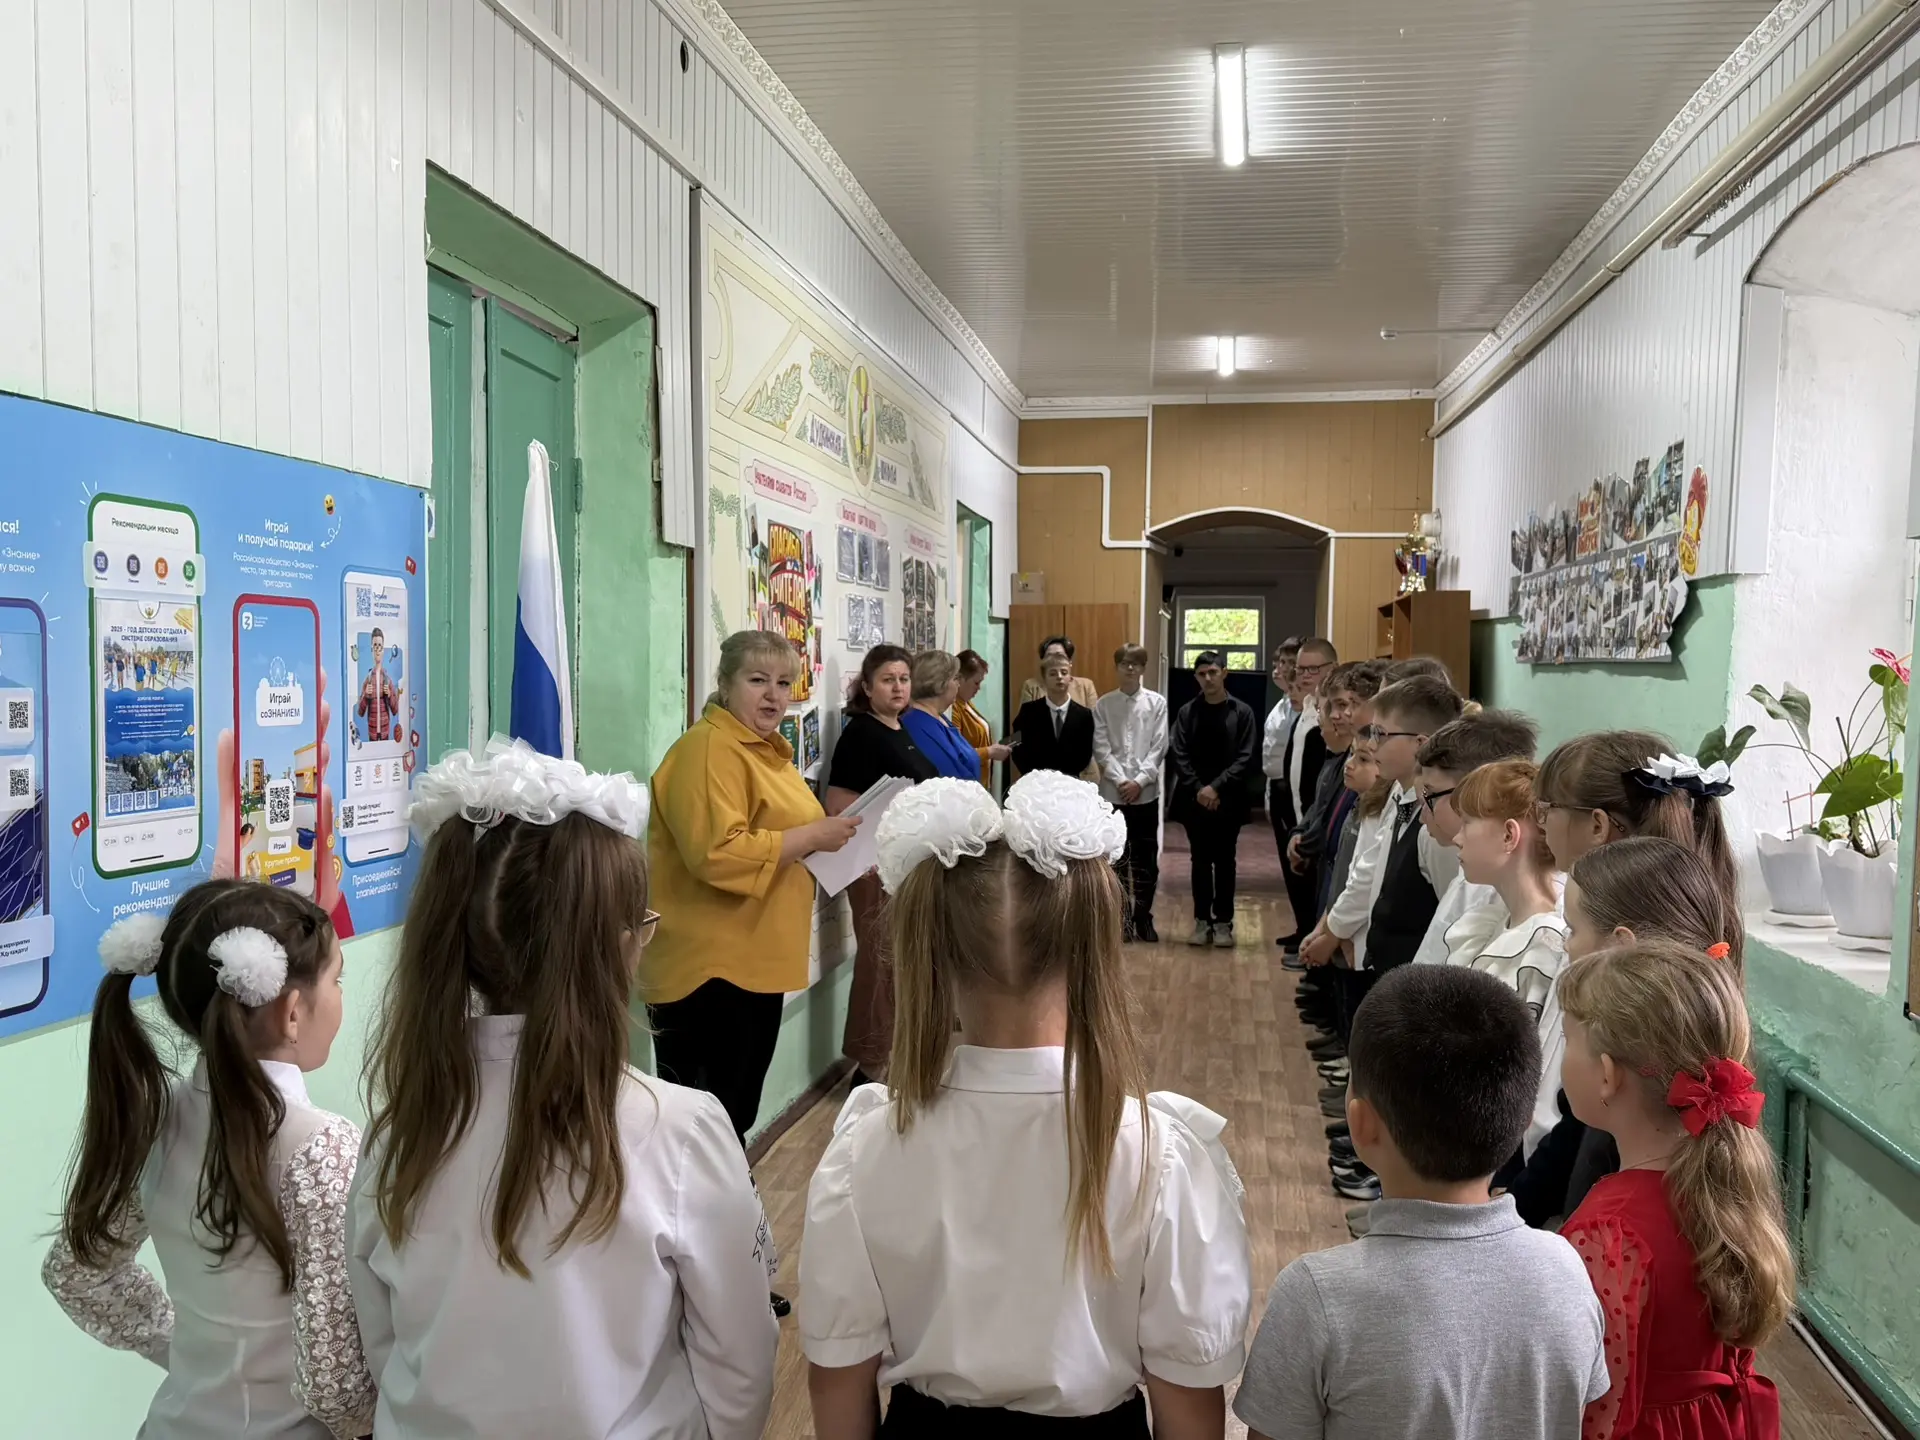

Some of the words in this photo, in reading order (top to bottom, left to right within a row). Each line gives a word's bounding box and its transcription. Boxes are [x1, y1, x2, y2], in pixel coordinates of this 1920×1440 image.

[264, 518, 289, 534] Играй
[237, 533, 244, 543] и
[245, 534, 279, 548] получай
[280, 539, 314, 553] подарки!
[269, 692, 292, 706] Играй
[260, 707, 301, 719] соЗНАНИЕМ
[130, 877, 171, 896] Лучшие
[113, 892, 183, 919] рекомендаци
